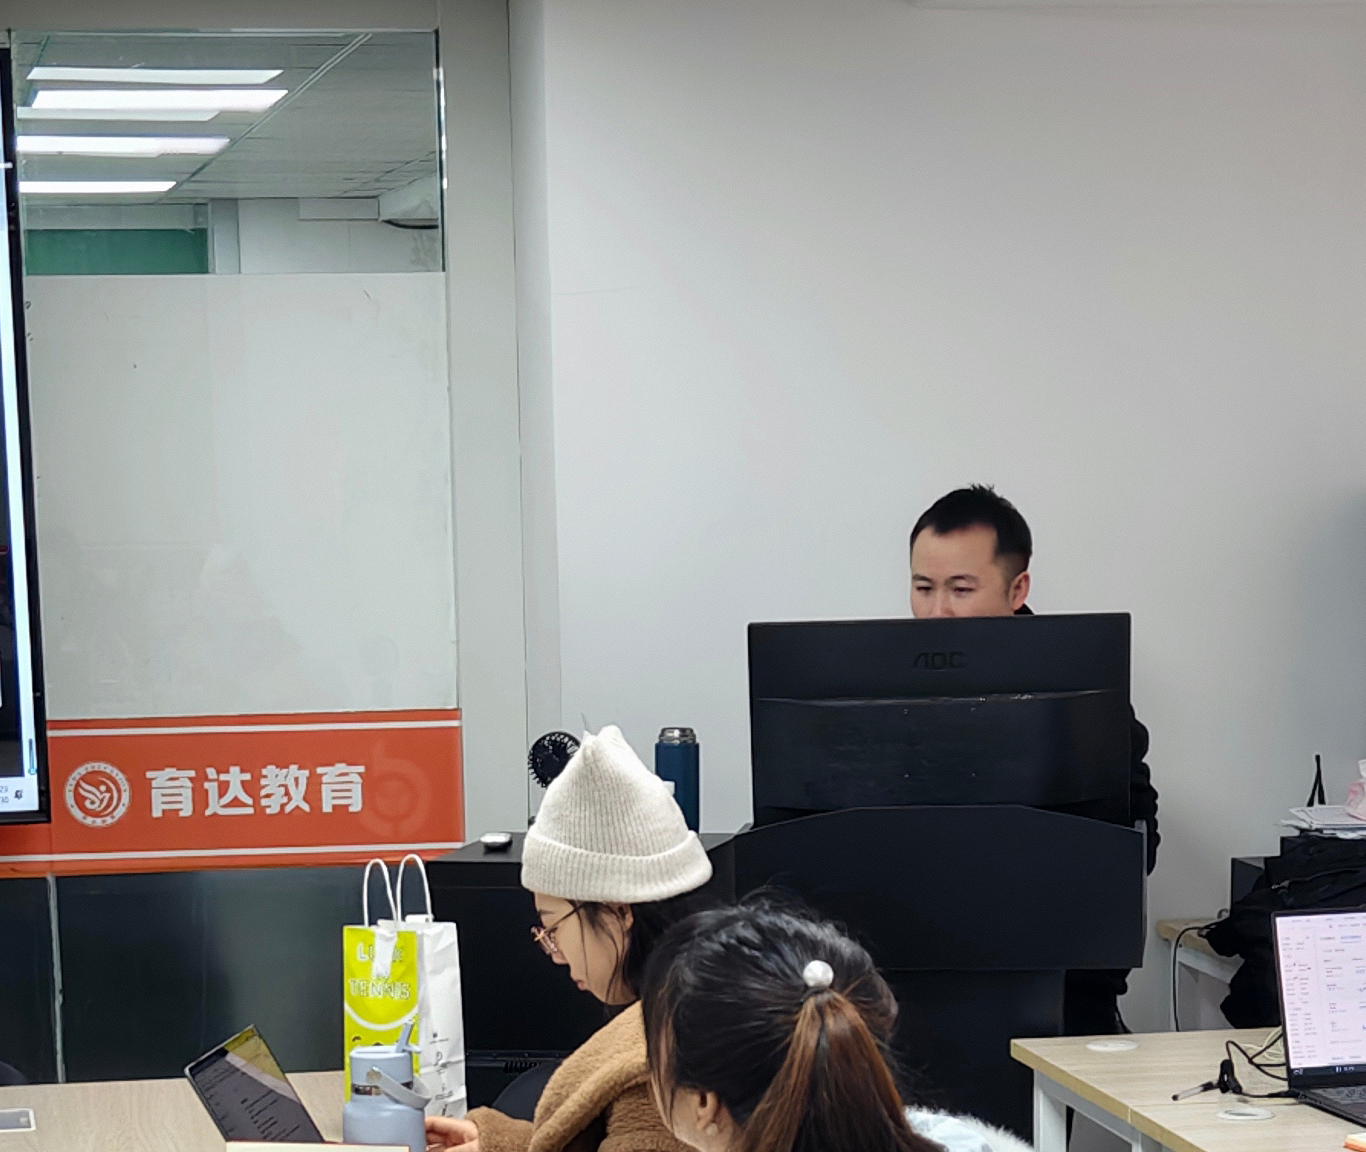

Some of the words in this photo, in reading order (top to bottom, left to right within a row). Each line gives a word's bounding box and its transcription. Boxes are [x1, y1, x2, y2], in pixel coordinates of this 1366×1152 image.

[912, 651, 966, 670] AOC
[145, 762, 366, 819] 育达教育
[349, 978, 411, 1000] TENNIS
